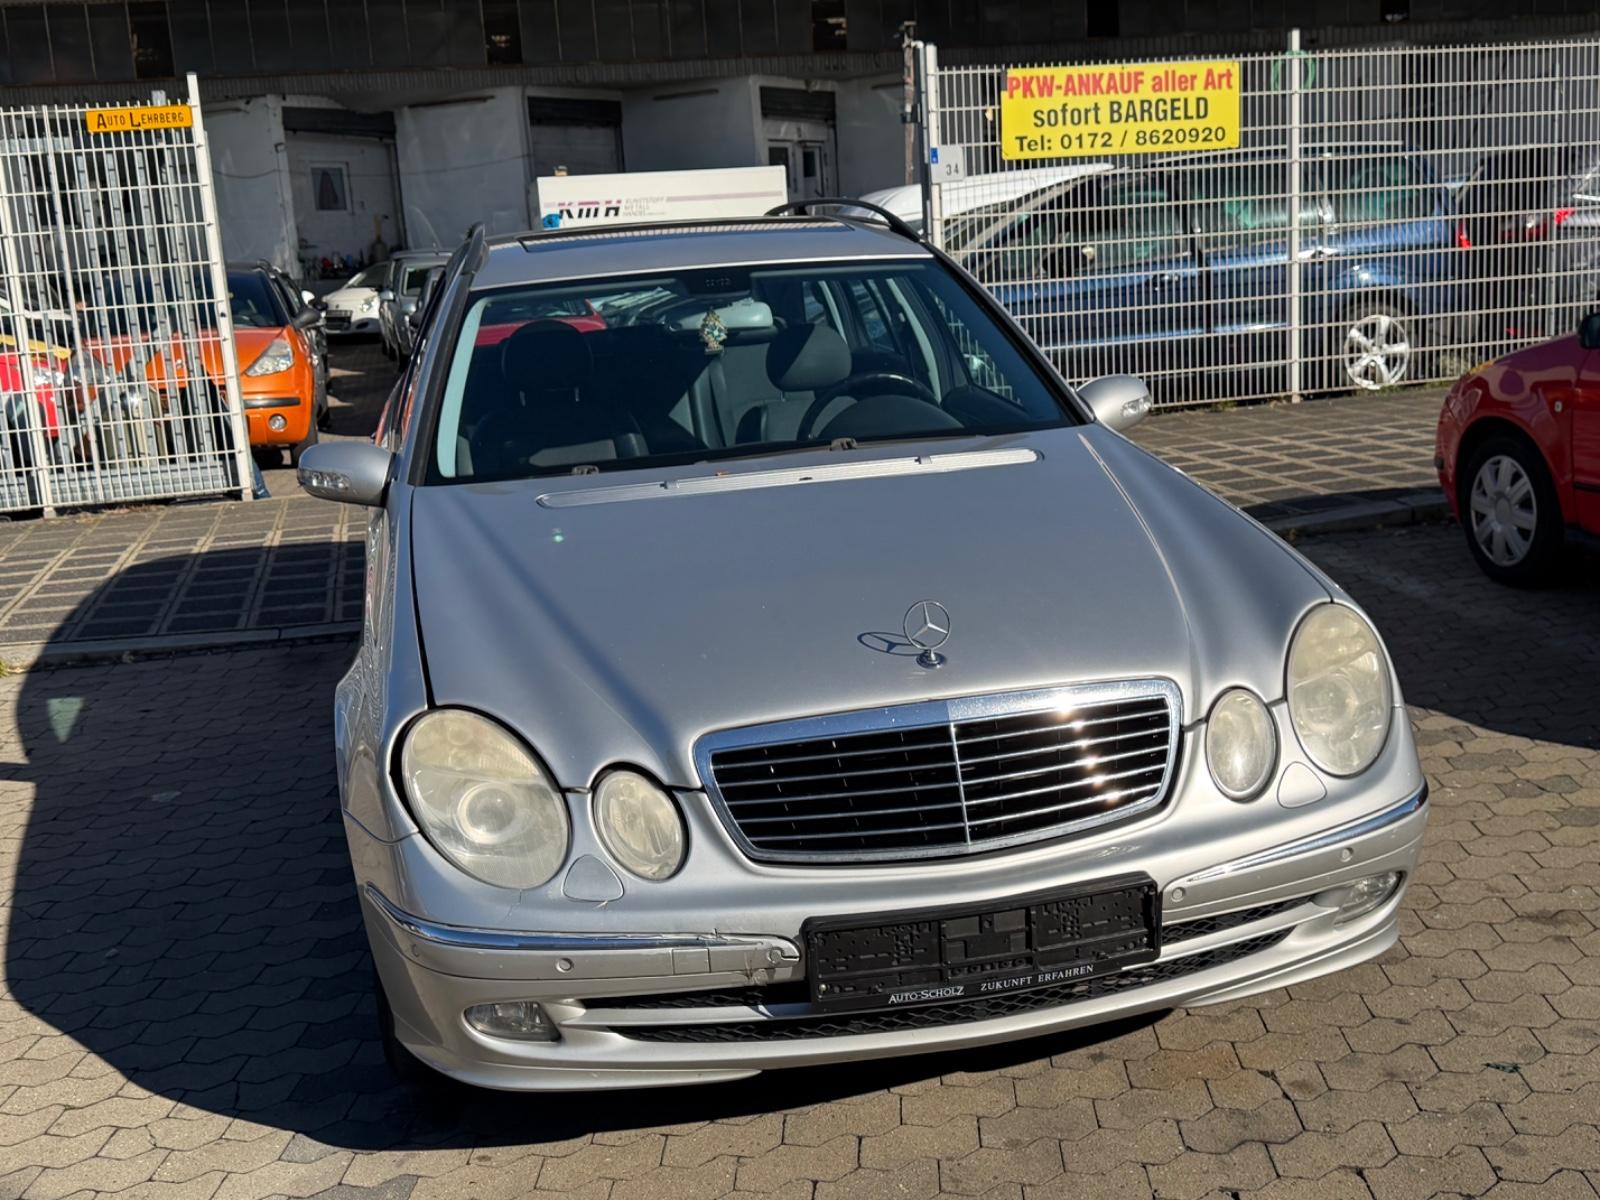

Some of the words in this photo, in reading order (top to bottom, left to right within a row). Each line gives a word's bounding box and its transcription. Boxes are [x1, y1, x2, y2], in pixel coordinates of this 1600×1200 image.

[1007, 71, 1144, 99] PKW-ANKAUF
[1151, 70, 1197, 93] aller
[1203, 68, 1233, 90] Art
[1033, 102, 1100, 128] sofort
[1109, 97, 1208, 124] BARGELD
[1015, 135, 1052, 152] Tel:
[1060, 132, 1113, 150] 0172
[1119, 130, 1128, 147] /
[1135, 126, 1226, 146] 8620920
[946, 163, 959, 176] 34
[888, 986, 965, 1004] AUTO-SCHOLZ
[981, 976, 1033, 991] ZUKUNFT
[1038, 964, 1094, 983] ERFAHREN
